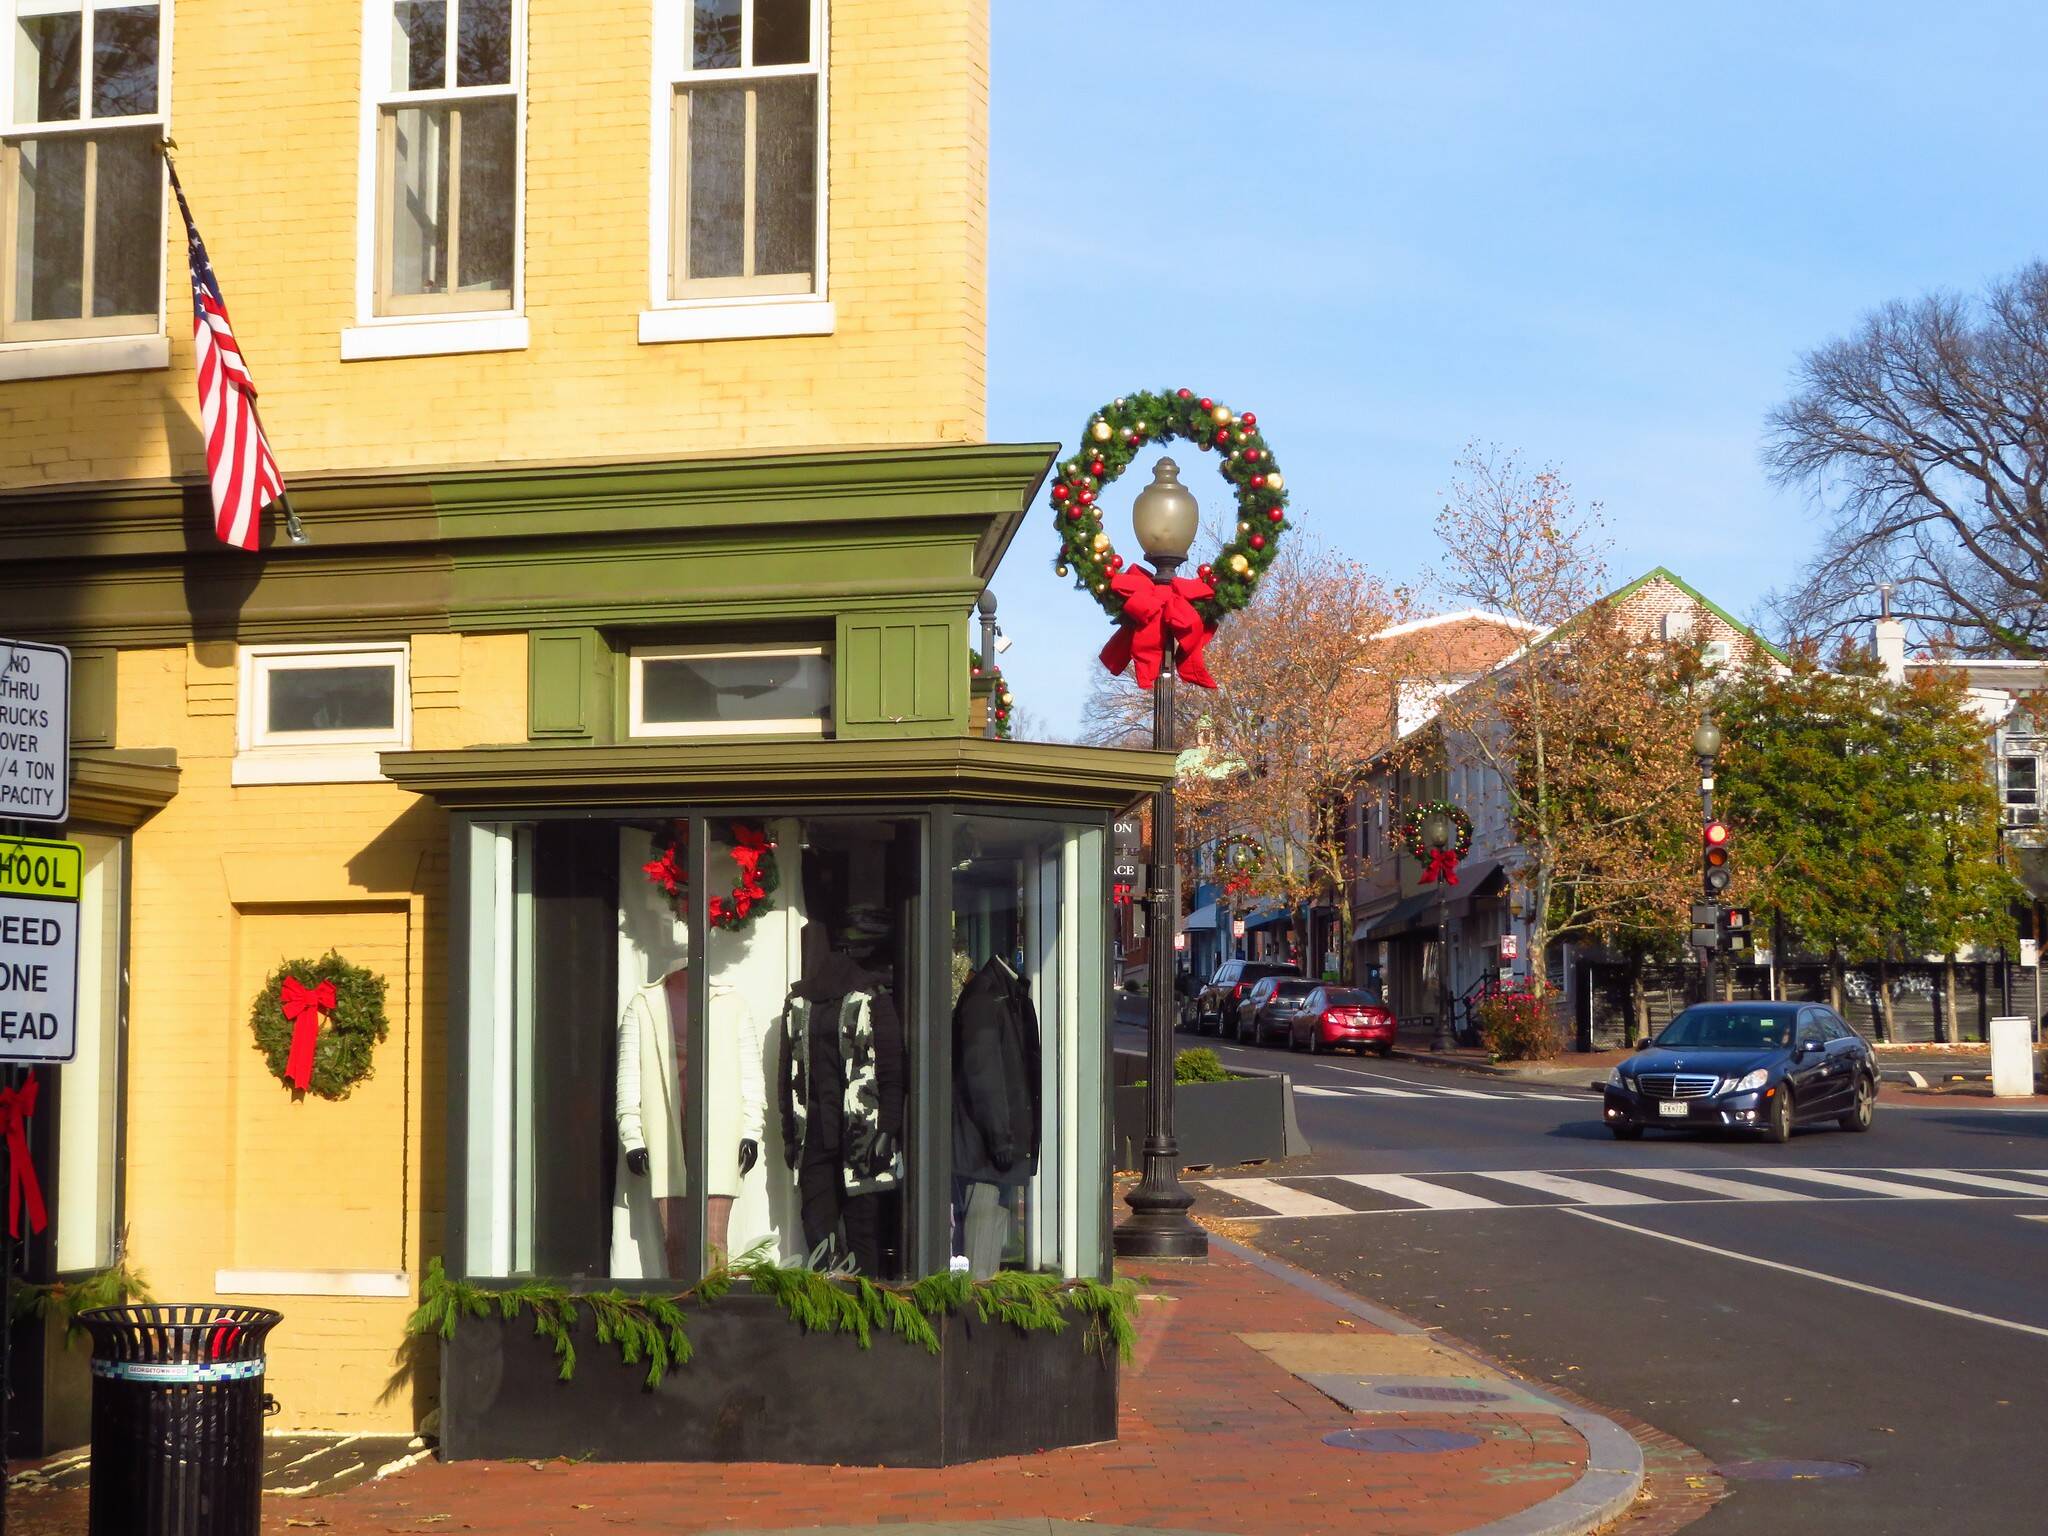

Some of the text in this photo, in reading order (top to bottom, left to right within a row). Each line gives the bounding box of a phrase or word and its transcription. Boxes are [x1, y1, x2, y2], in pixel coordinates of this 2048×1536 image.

[10, 654, 30, 674] NO
[1, 679, 39, 701] THRU
[0, 732, 38, 753] OVER
[26, 760, 54, 781] TON
[0, 784, 54, 806] PACITY
[1113, 823, 1132, 833] ON
[0, 852, 66, 888] HOOL
[0, 916, 61, 946] EED
[1, 1011, 58, 1040] EAD
